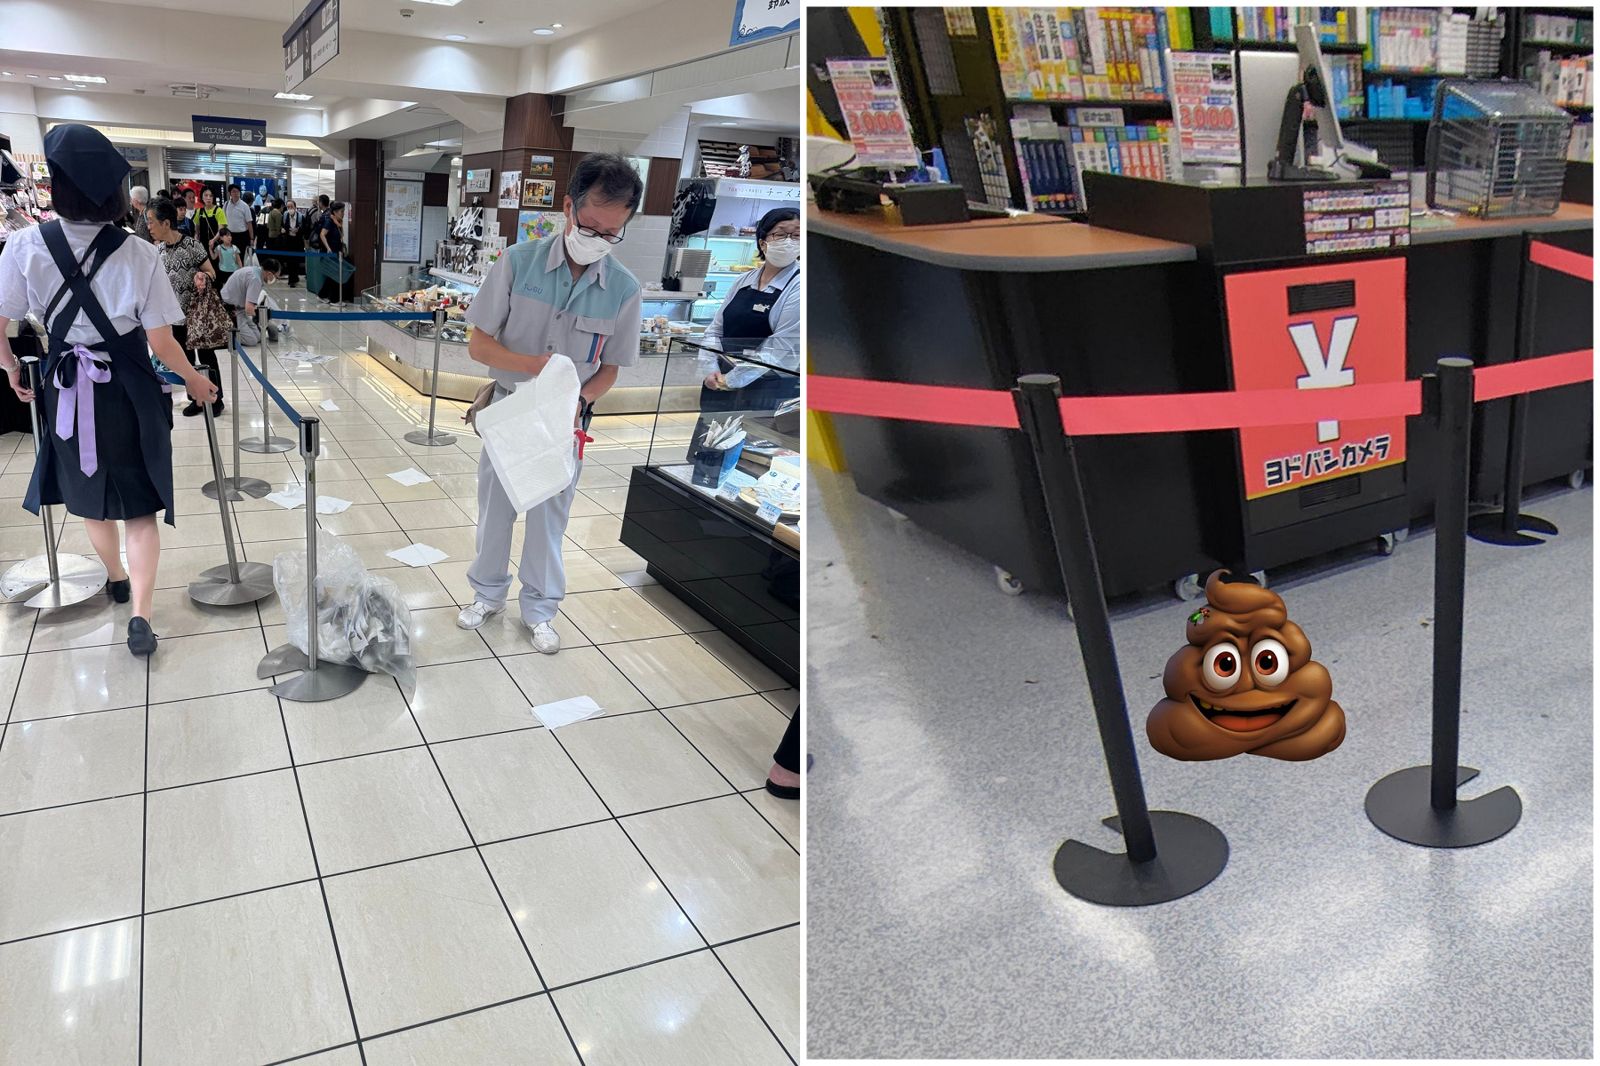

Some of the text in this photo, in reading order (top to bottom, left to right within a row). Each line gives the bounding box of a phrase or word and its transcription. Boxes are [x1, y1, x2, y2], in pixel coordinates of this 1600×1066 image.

[1264, 435, 1391, 487] ヨドバシカメラ
